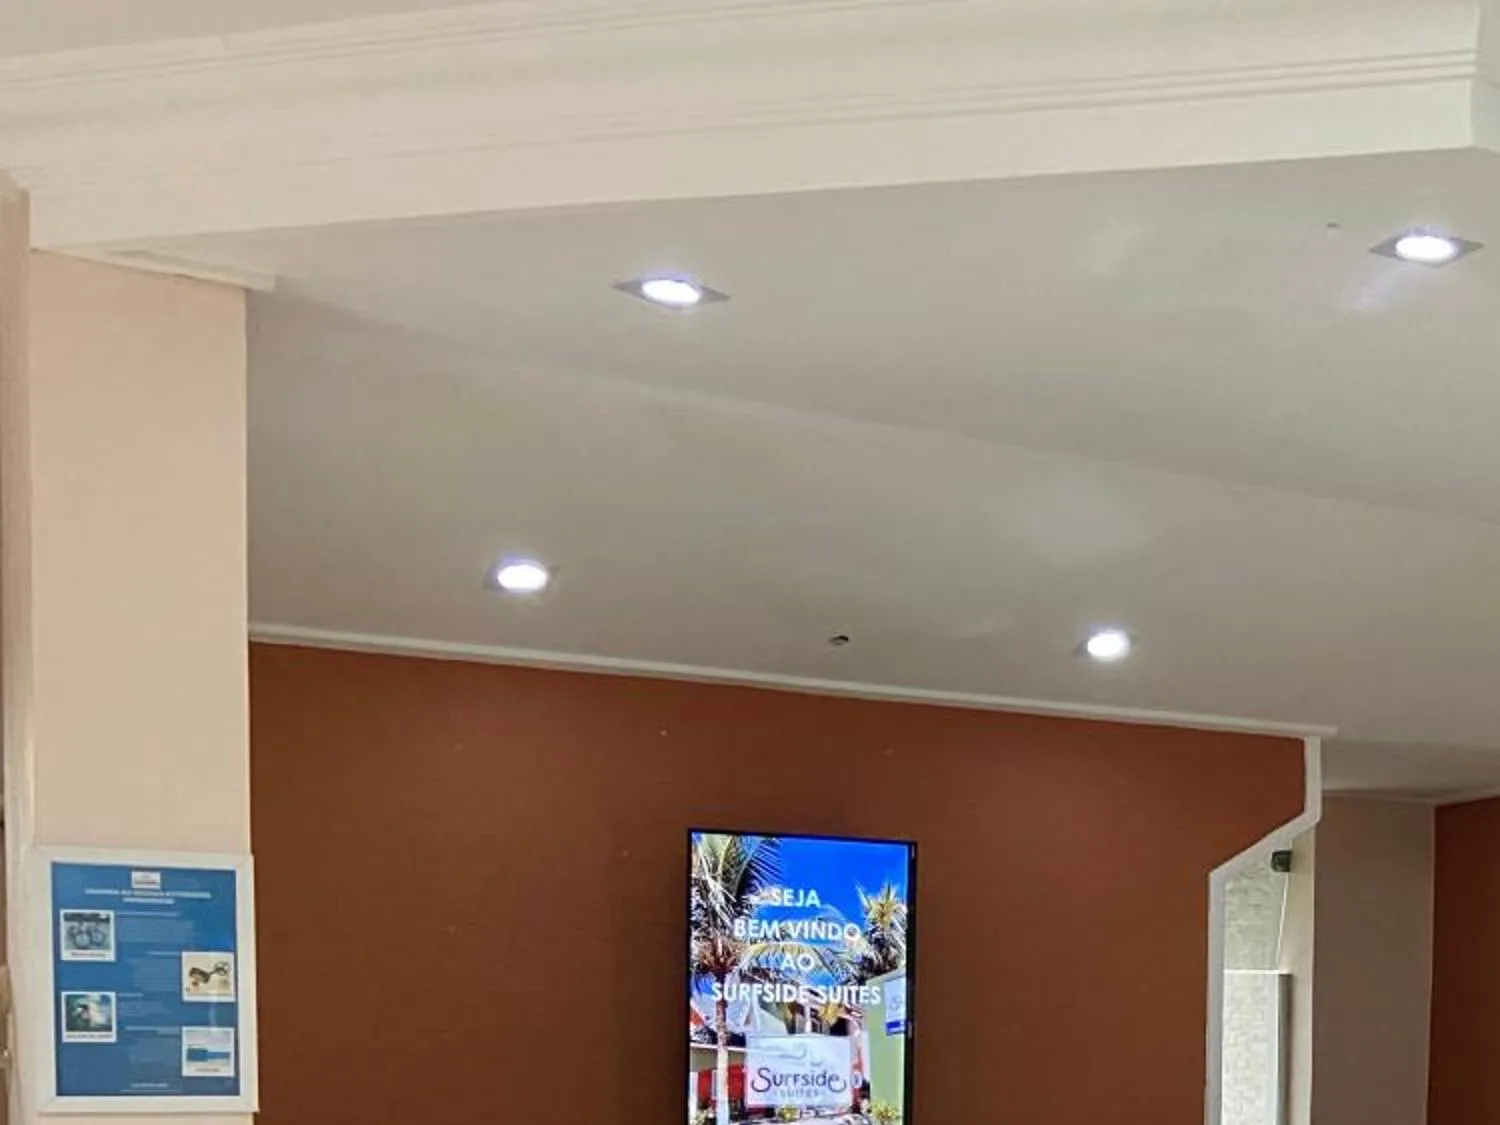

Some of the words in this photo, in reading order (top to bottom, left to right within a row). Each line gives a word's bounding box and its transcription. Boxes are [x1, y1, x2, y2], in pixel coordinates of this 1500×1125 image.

[772, 888, 821, 908] SEJA
[733, 919, 780, 939] BEM
[785, 921, 861, 941] VINDO
[781, 953, 815, 971] AO
[711, 982, 811, 1002] SURFSIDE
[814, 985, 881, 1005] SUITES
[752, 1066, 847, 1093] Surfside
